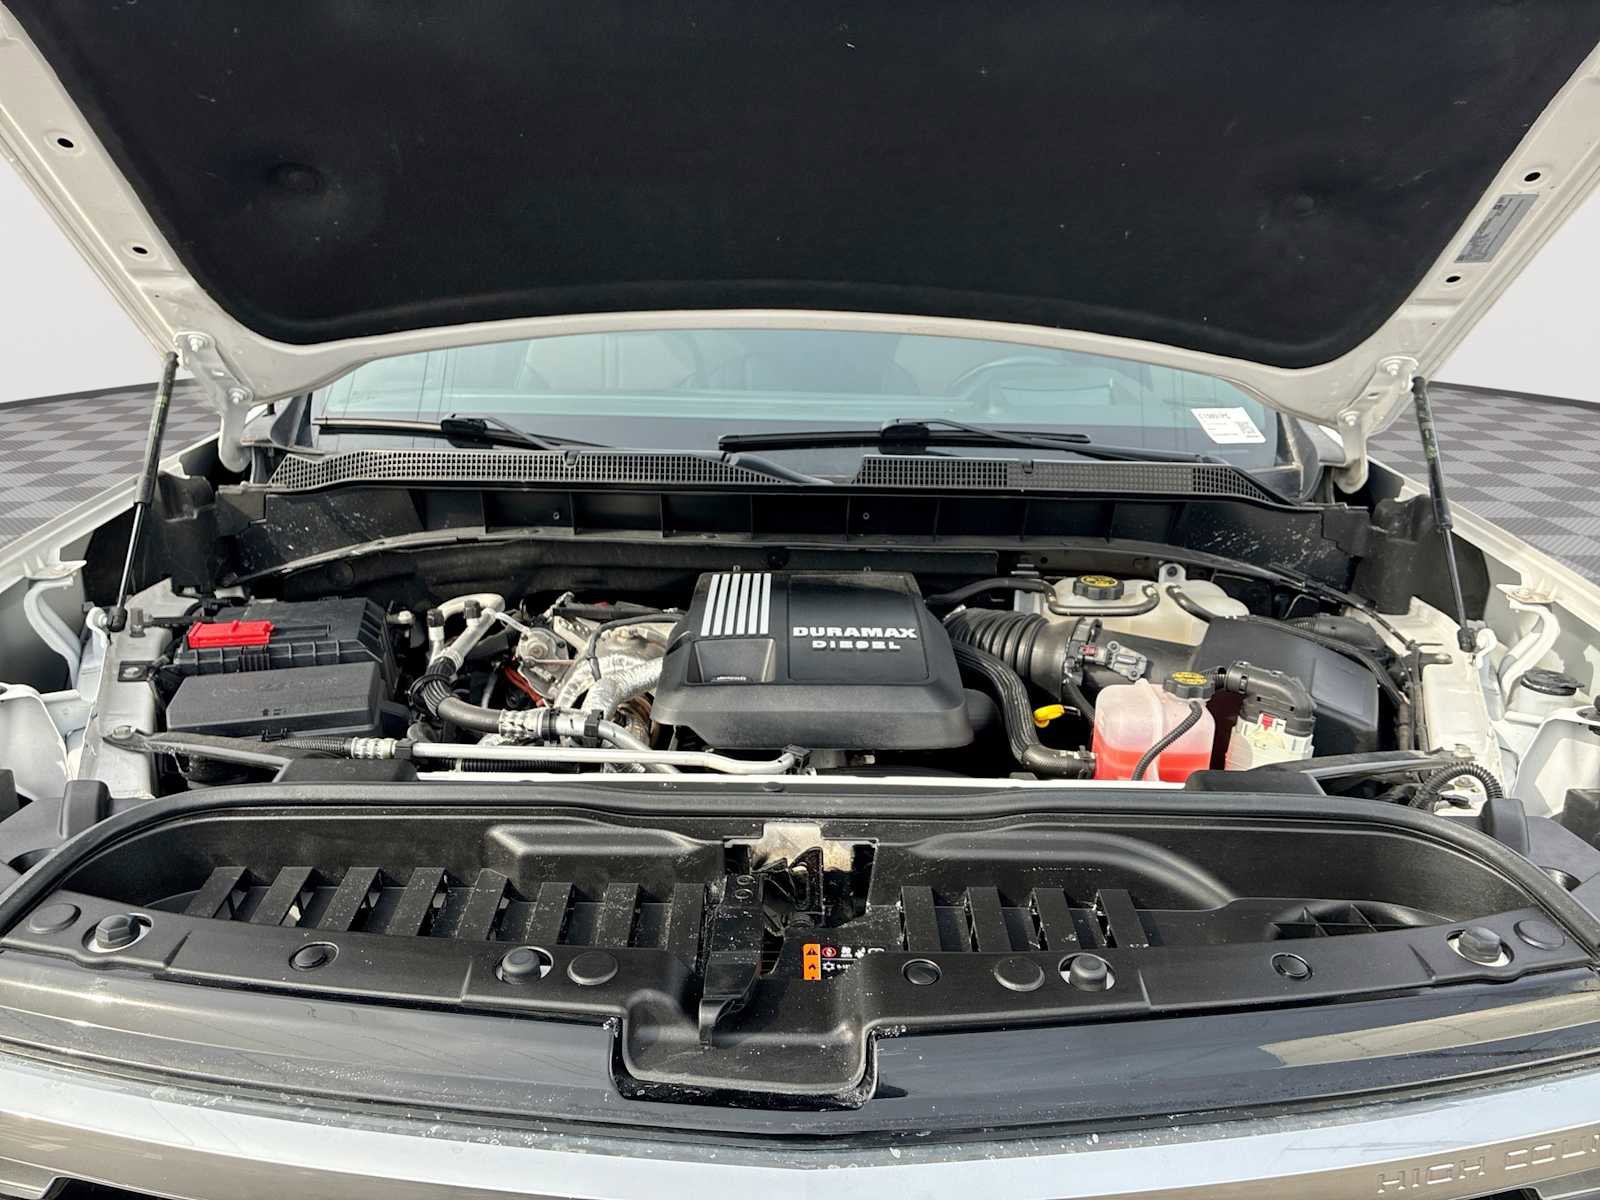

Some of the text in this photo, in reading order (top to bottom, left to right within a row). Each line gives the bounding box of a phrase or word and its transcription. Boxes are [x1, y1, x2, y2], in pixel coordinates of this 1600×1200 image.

[792, 626, 918, 639] DURAMAX
[811, 640, 901, 650] DIESEL
[1376, 1156, 1486, 1194] HIGH
